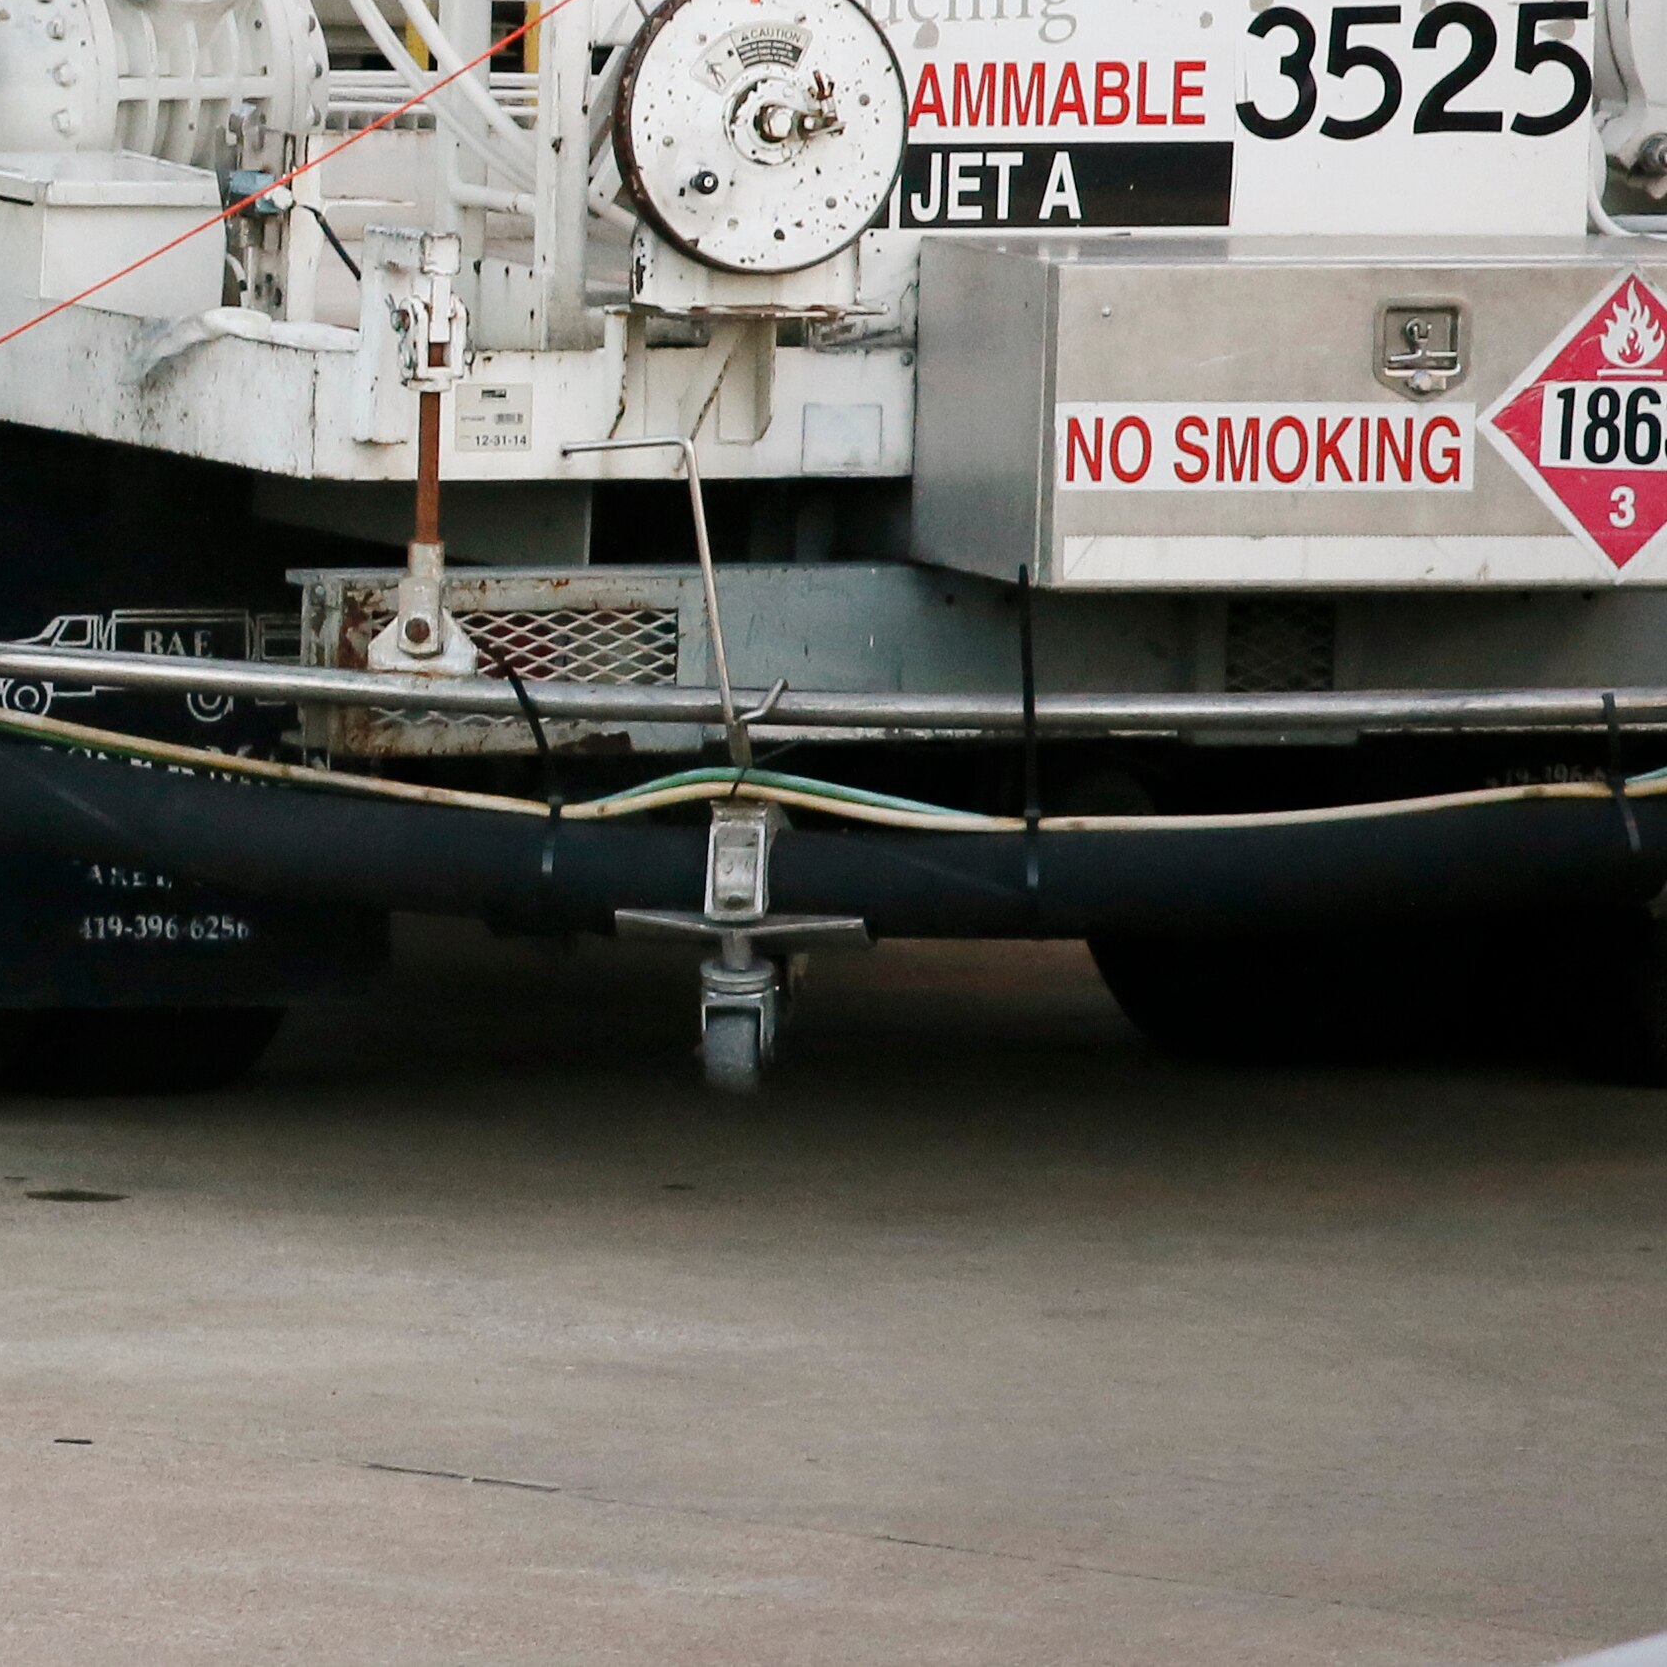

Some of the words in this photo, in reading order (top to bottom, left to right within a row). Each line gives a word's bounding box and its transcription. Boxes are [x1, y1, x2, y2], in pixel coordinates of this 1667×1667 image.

[750, 27, 802, 43] CAUTION
[908, 60, 1207, 128] AMMABLE
[1235, 1, 1593, 141] 3525
[910, 152, 1024, 222] JET
[1039, 151, 1082, 220] A
[475, 435, 527, 446] 12-31-14
[1066, 416, 1153, 483] NO
[1173, 415, 1462, 484] SMOKING
[1557, 387, 1667, 465] 186
[1609, 486, 1636, 528] 3
